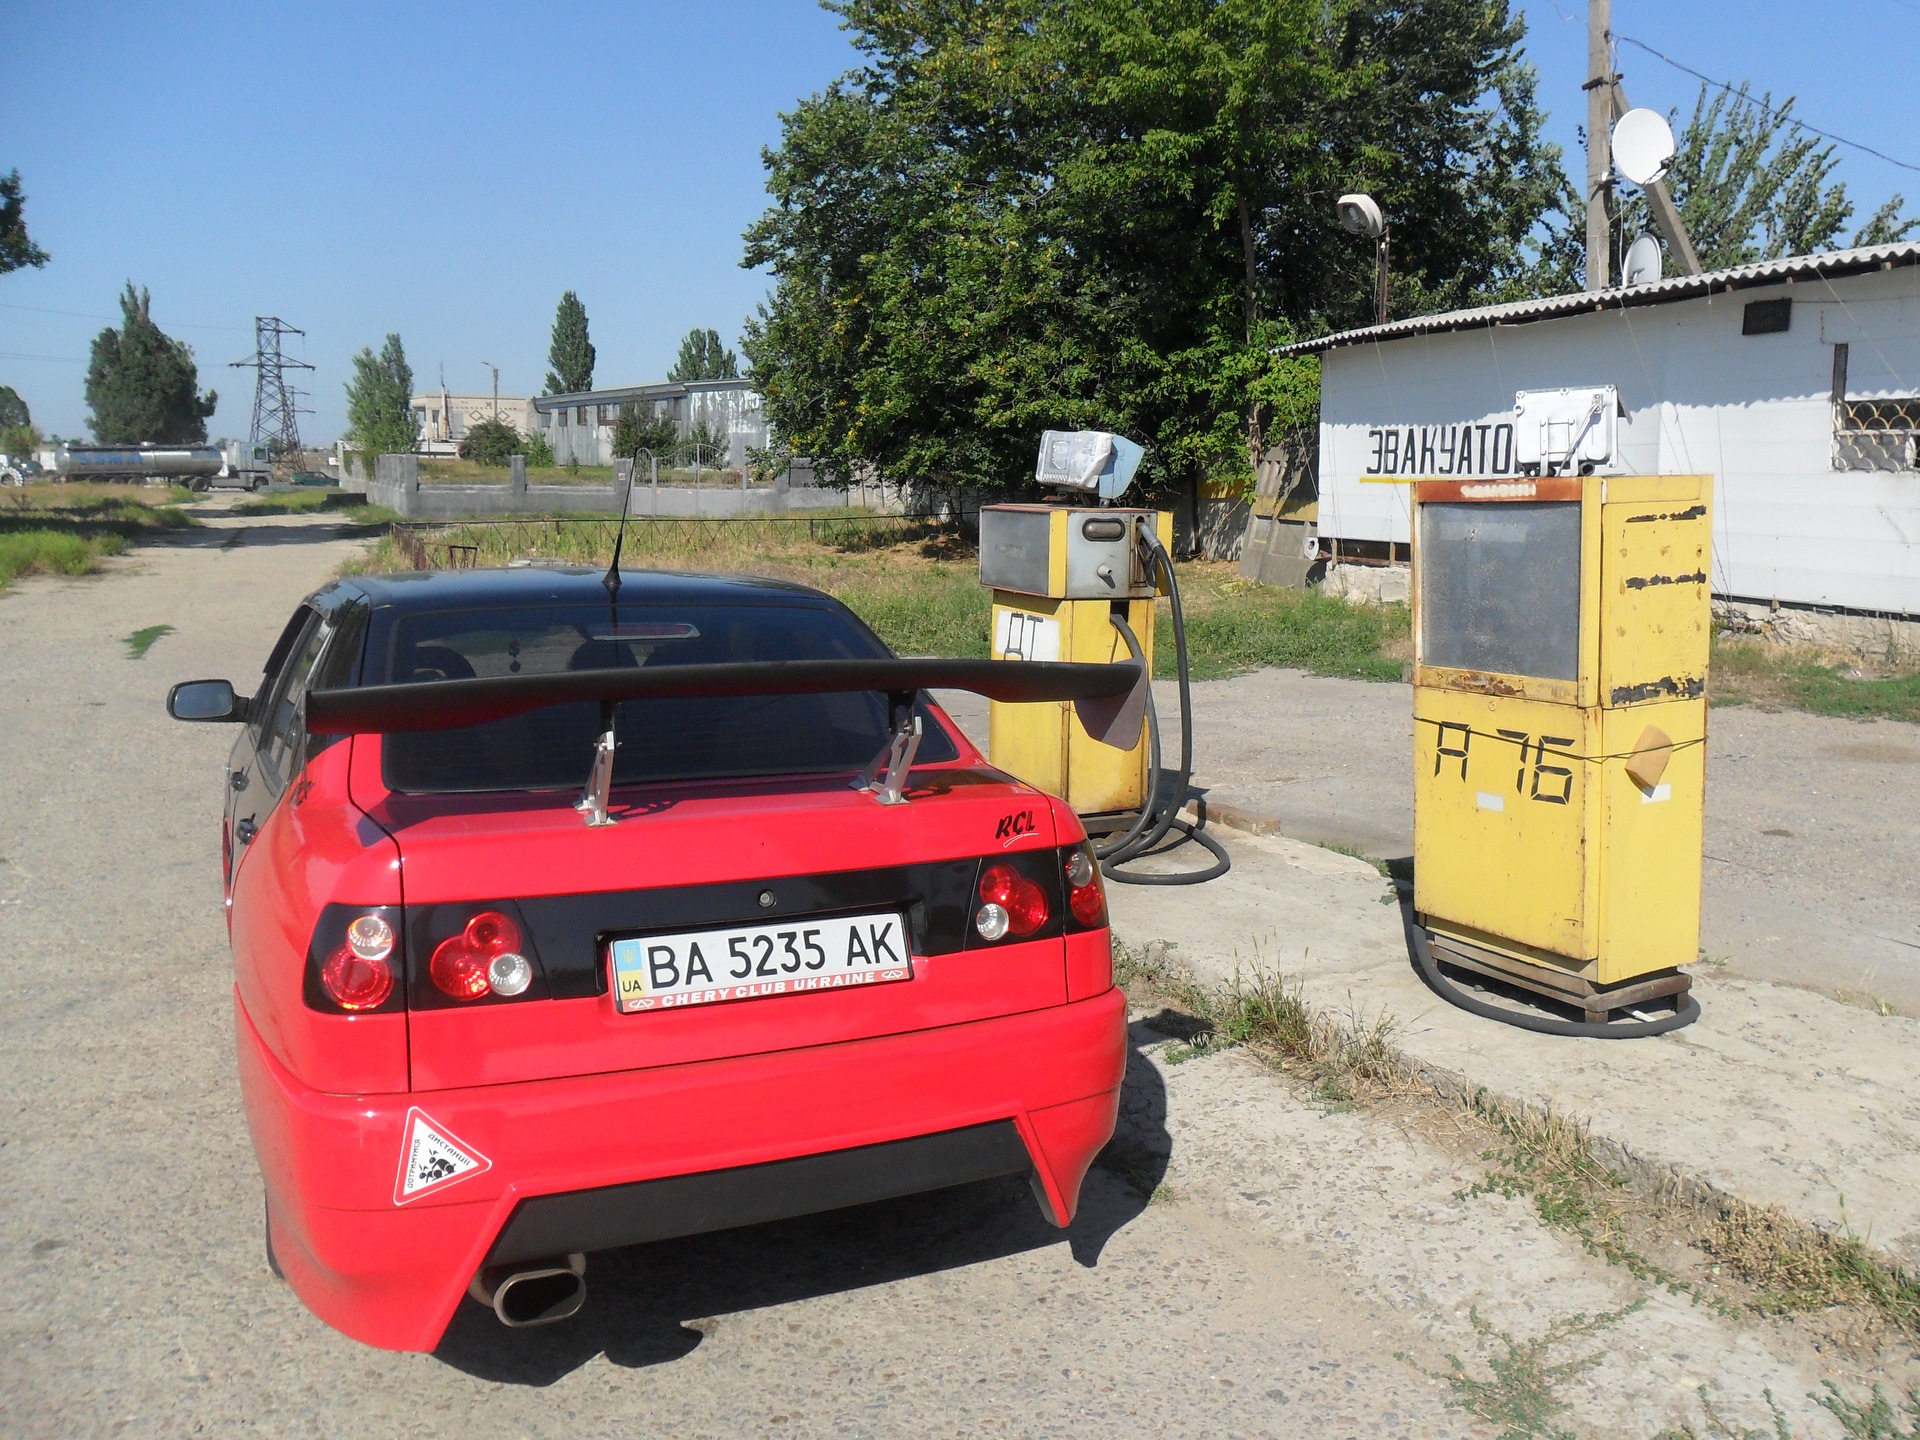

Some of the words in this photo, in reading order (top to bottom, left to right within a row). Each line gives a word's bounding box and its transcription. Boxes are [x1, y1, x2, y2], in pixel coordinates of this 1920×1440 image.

[1366, 423, 1520, 475] ЭВАКУАТО
[1496, 728, 1576, 805] 76
[995, 810, 1036, 839] RCL
[647, 942, 714, 990] BA
[728, 929, 826, 979] 5235
[846, 922, 899, 967] AK
[622, 979, 642, 993] UA
[661, 987, 731, 1007] CHERY
[735, 981, 786, 998] CLUB
[793, 971, 875, 991] UKRAINE
